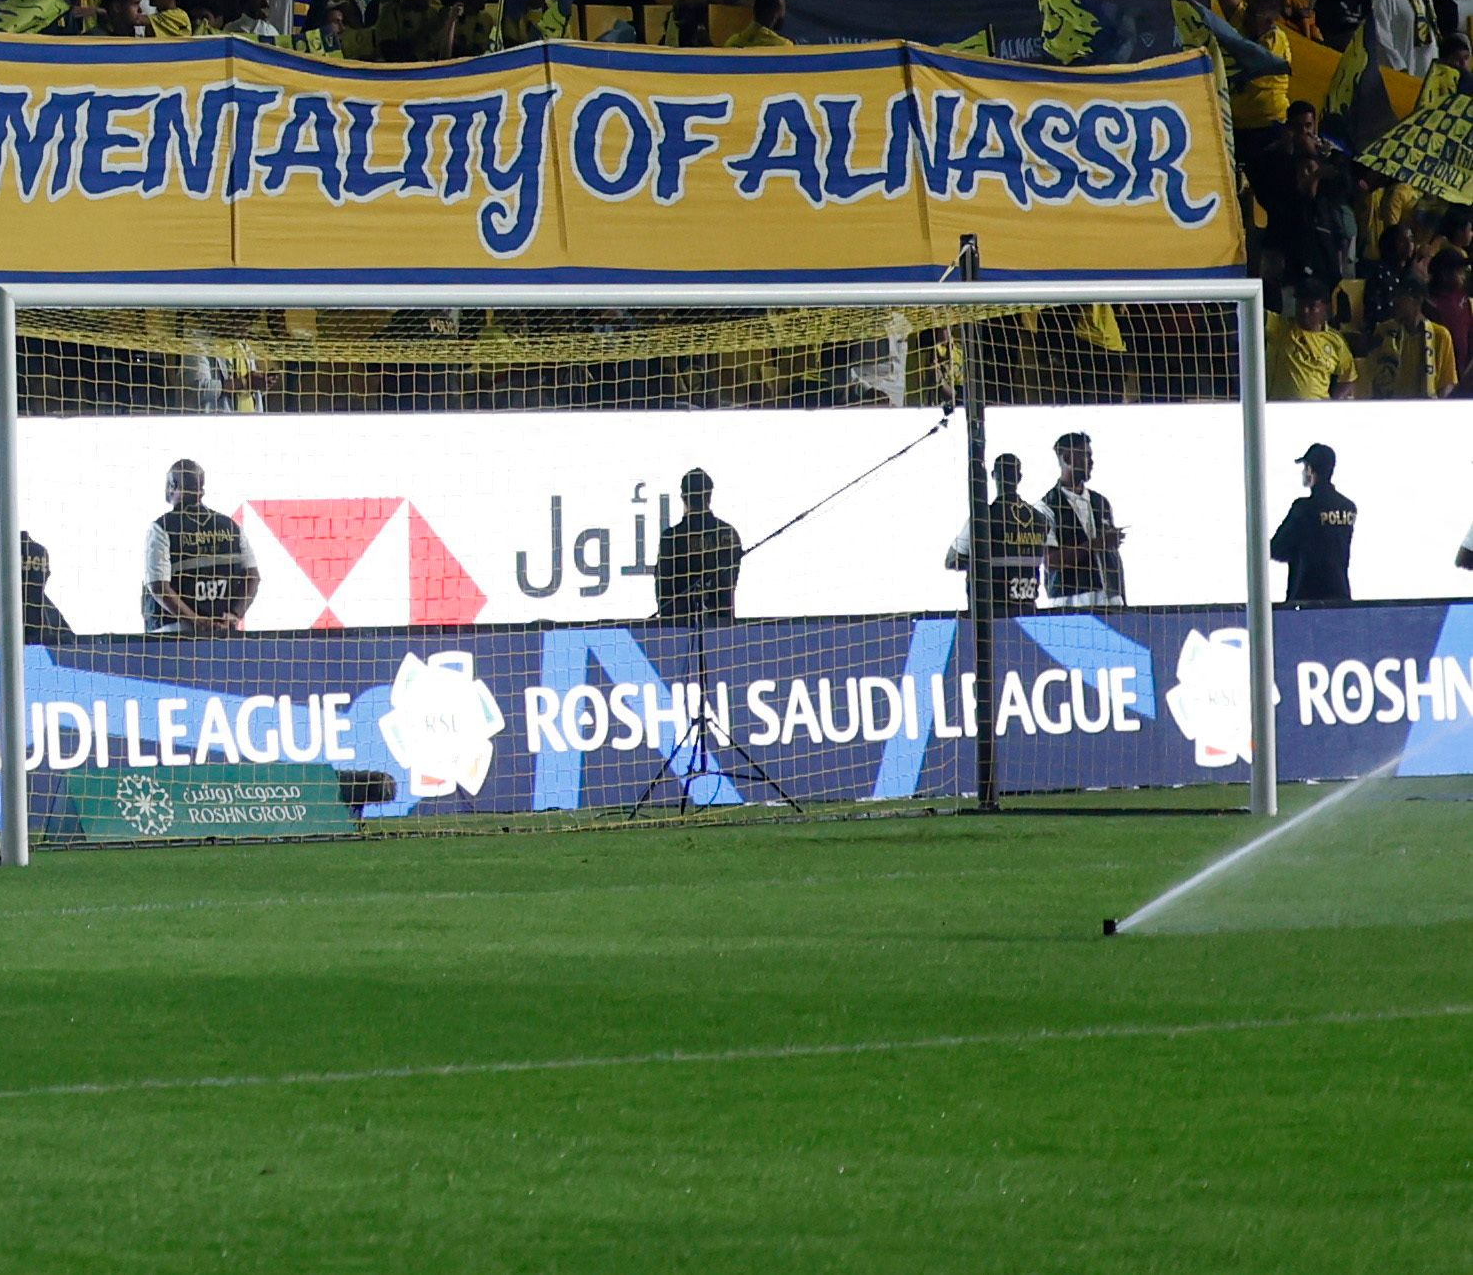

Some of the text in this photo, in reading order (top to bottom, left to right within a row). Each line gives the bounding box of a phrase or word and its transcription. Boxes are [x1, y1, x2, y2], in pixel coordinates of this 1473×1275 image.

[572, 84, 735, 206] OF
[725, 89, 1220, 231] ALNASSR
[1433, 156, 1470, 193] ONLY
[1320, 511, 1356, 526] POLIC
[195, 580, 226, 602] 087
[1297, 656, 1473, 726] ROSHN
[127, 692, 357, 767] LEAGUE
[525, 680, 729, 753] ROSHN
[748, 674, 918, 747] SAUDI
[183, 783, 301, 804] مجموعة روشن
[189, 804, 308, 825] ROSHN GROUP
